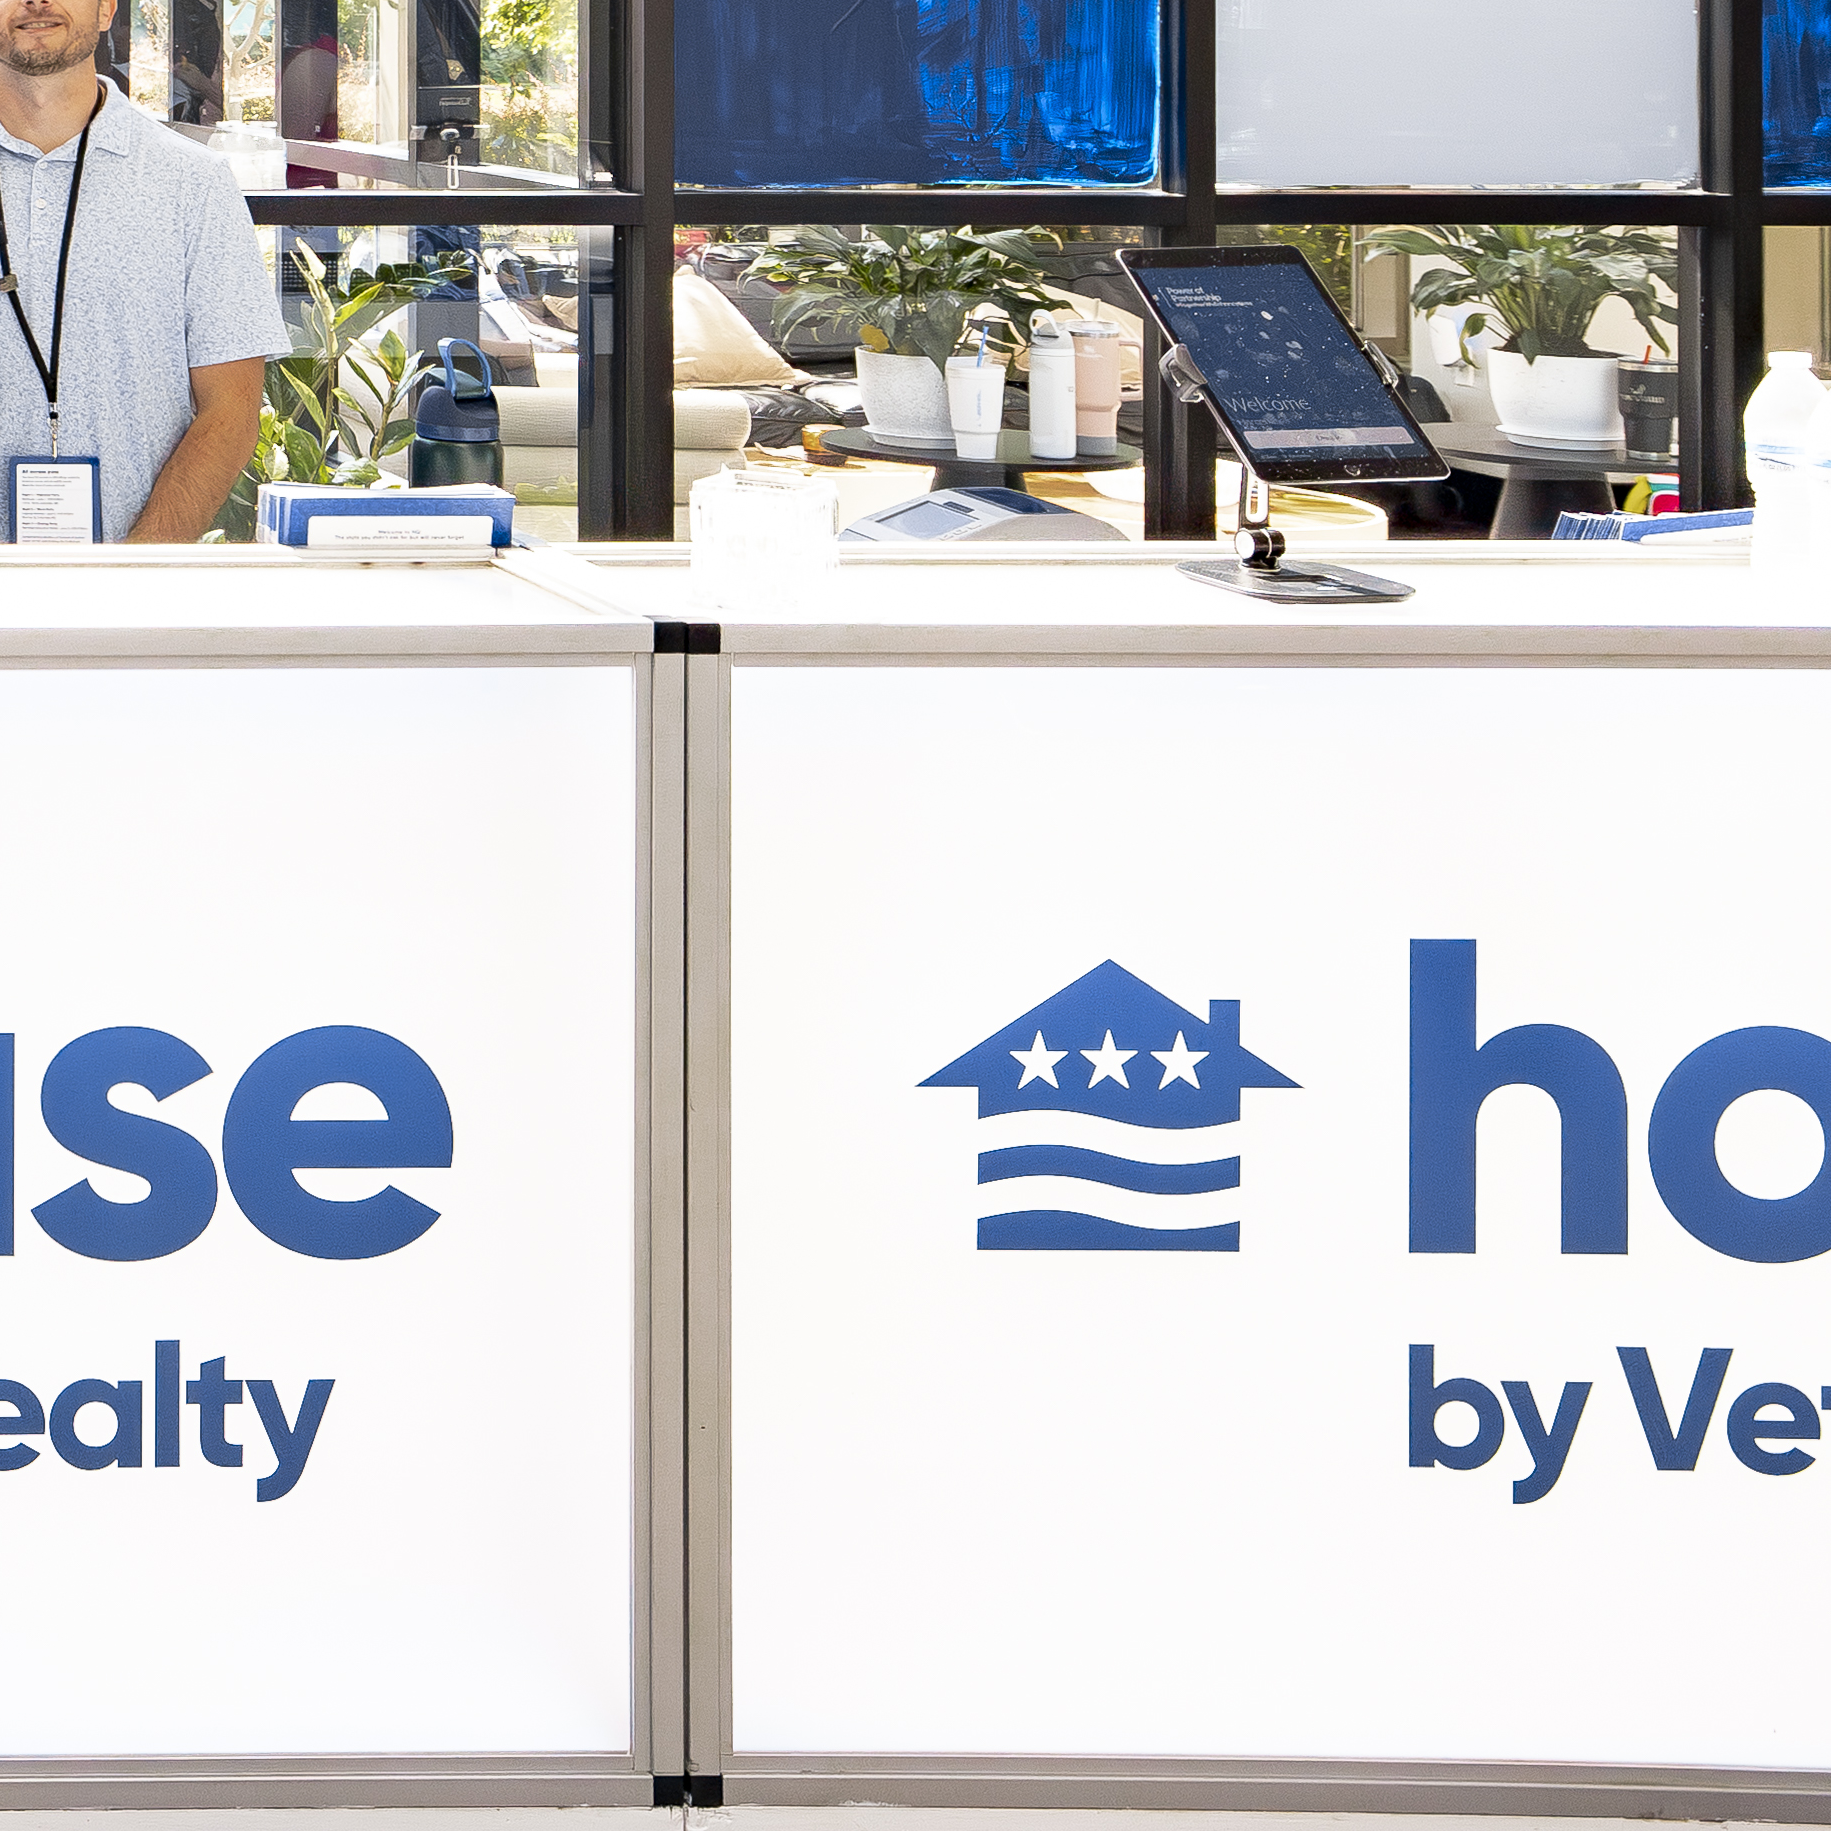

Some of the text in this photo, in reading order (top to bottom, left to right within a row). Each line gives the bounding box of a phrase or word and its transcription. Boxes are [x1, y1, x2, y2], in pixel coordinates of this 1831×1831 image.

[1224, 397, 1312, 413] Welcome
[1409, 1345, 1831, 1504] by Ve
